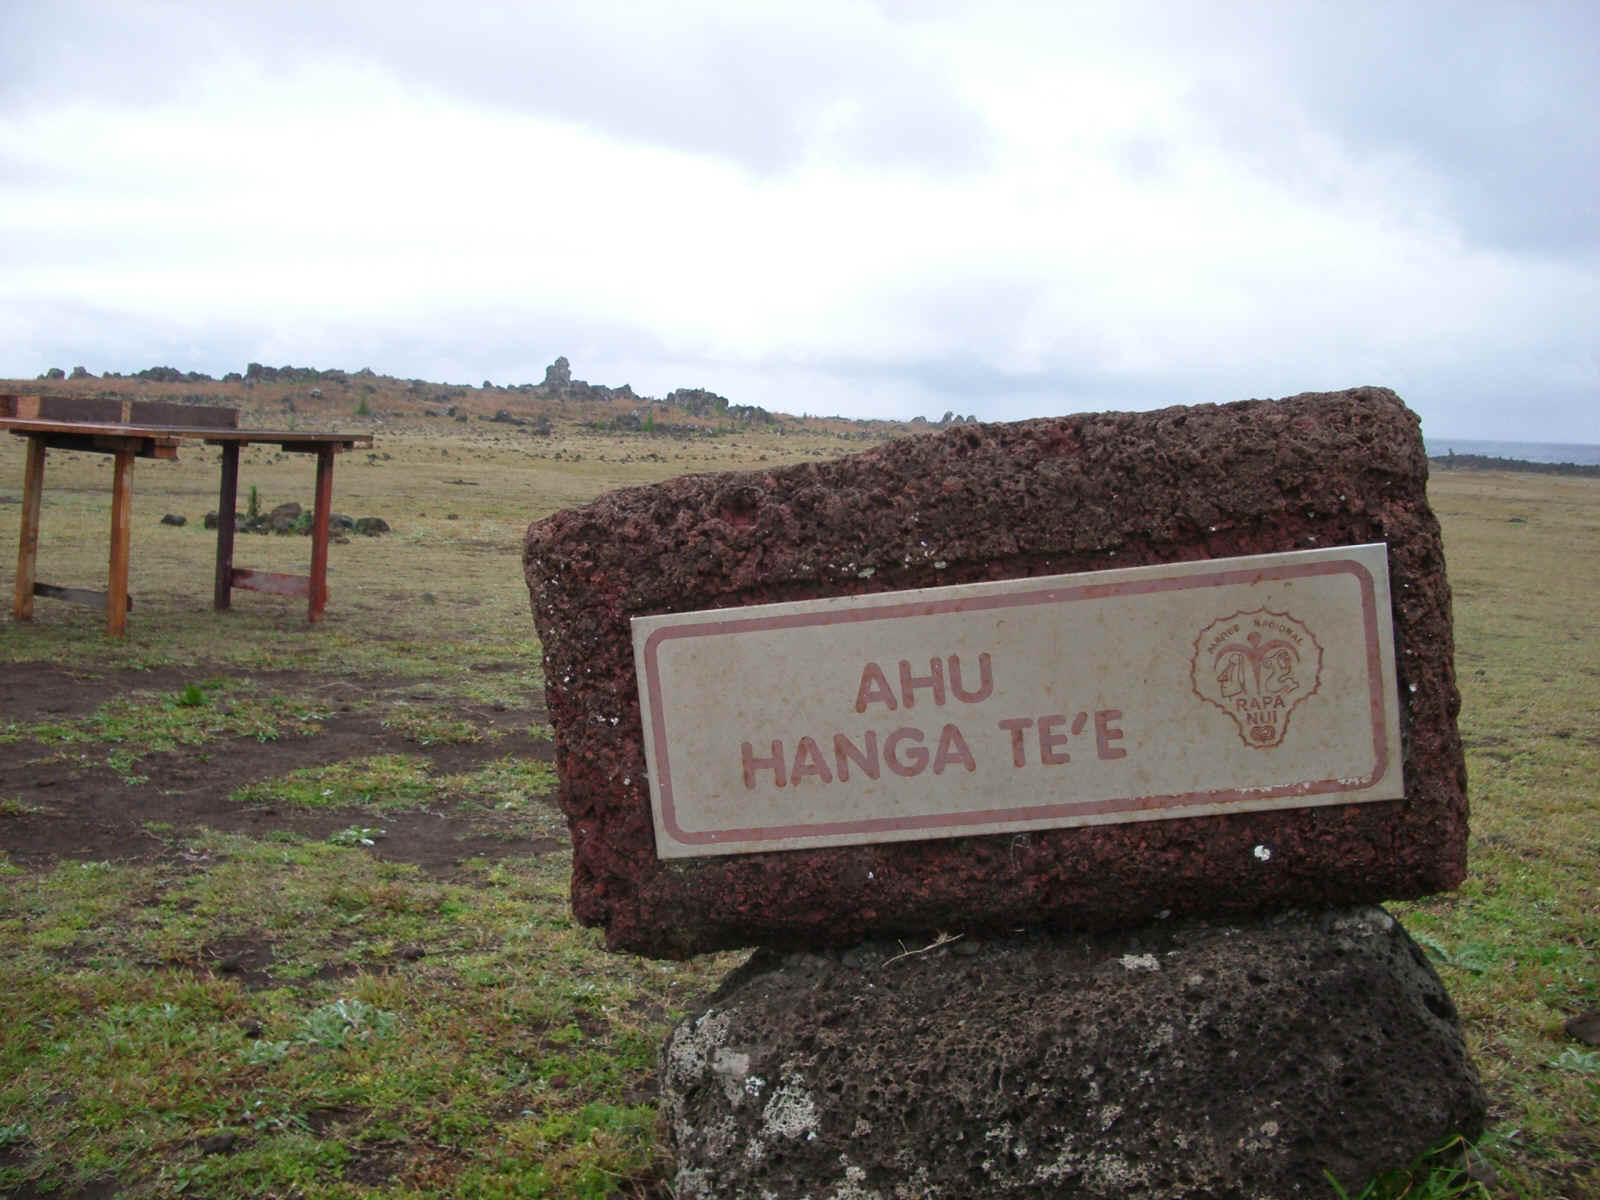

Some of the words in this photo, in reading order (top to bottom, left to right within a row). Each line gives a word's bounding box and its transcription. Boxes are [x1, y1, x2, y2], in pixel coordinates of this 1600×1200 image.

[855, 652, 994, 713] AHU
[1236, 696, 1285, 712] RAPA
[1246, 711, 1278, 725] NUI
[740, 723, 977, 789] HANGA
